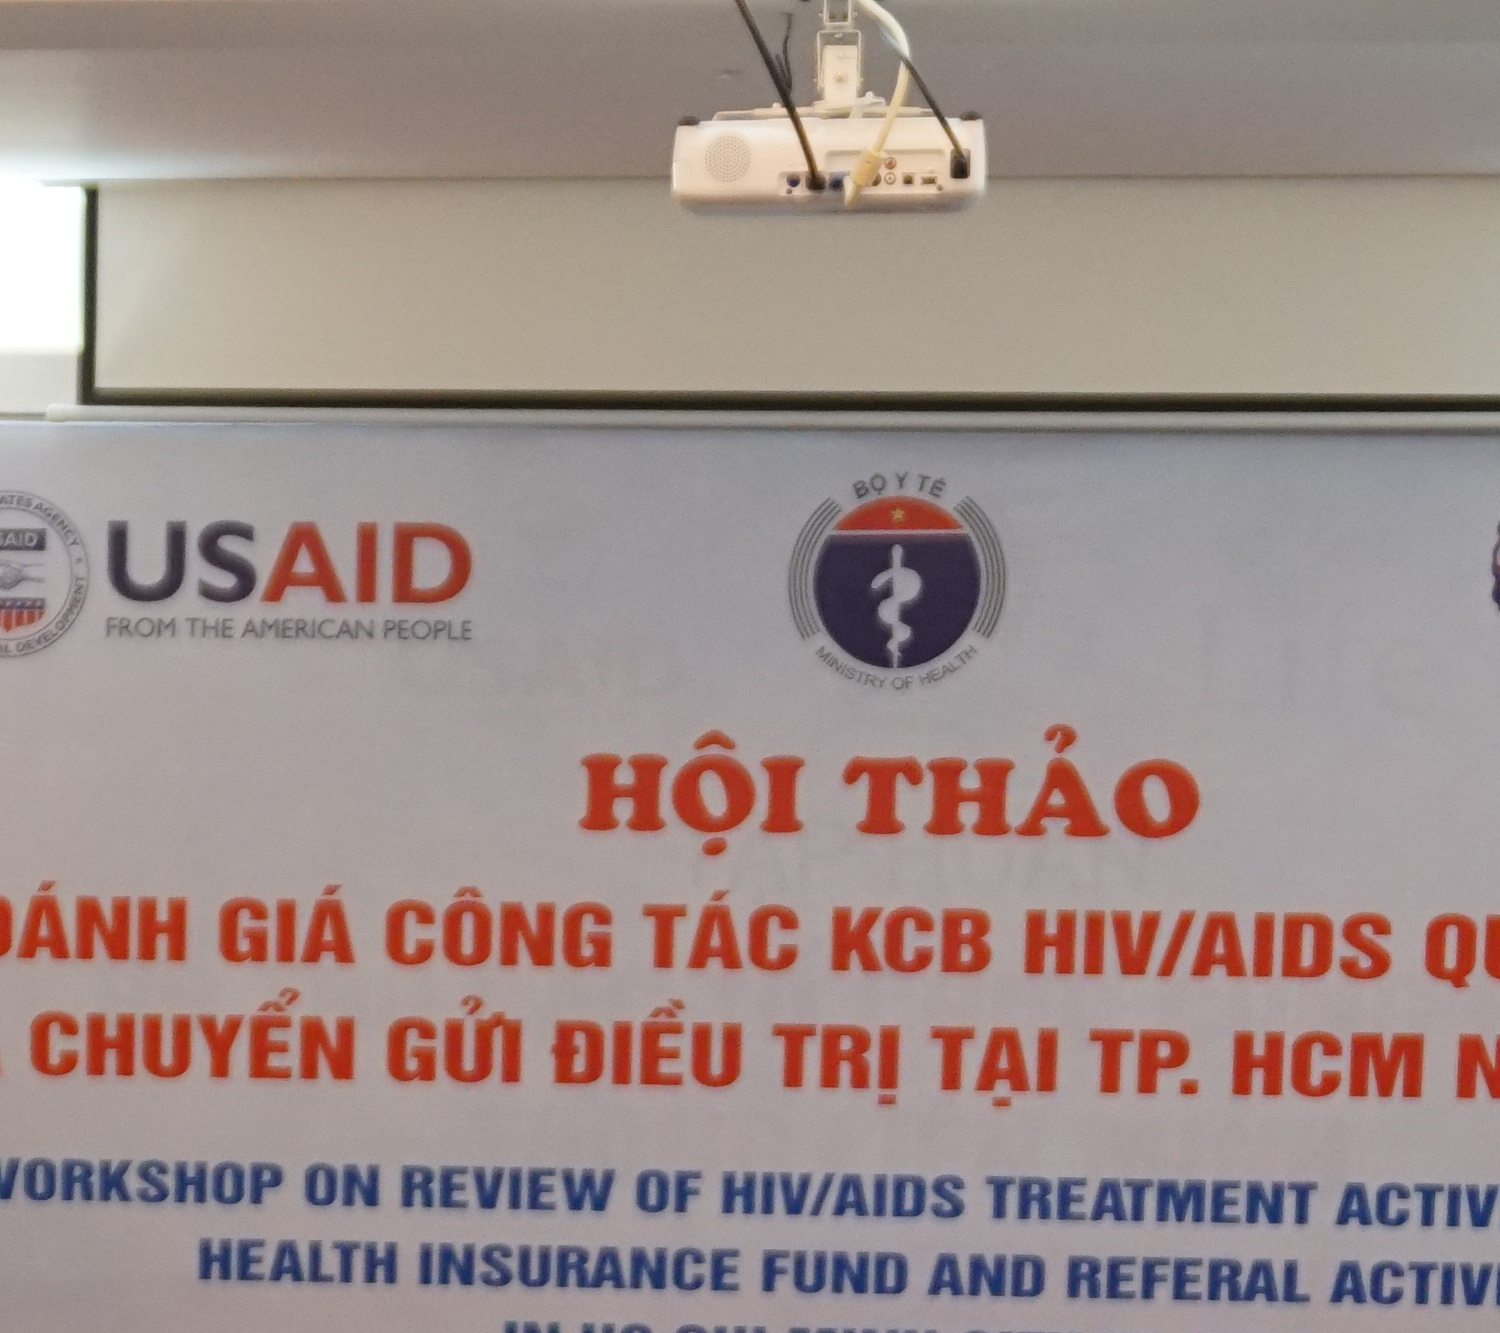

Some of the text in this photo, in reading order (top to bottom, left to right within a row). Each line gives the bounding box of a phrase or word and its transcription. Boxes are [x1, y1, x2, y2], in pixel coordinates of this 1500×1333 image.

[896, 472, 909, 489] Y
[108, 522, 472, 604] USAID
[106, 617, 472, 642] FROM THE AMERICAN PEOPLE
[815, 644, 978, 691] MINISTRY OF HEALTH
[580, 724, 1200, 857] HỘI THẢO
[219, 886, 355, 964] GIÁ
[386, 888, 612, 969] CÔNG
[643, 892, 799, 972] TÁC
[831, 907, 991, 974] KCB
[1024, 910, 1391, 980] HIV/AIDS
[30, 994, 355, 1081] CHUYỂN
[387, 997, 522, 1084] GỬI
[551, 1001, 742, 1088] ĐIỀU
[772, 1024, 899, 1105] TRỊ
[930, 1027, 1058, 1107] TẠI
[1090, 1030, 1198, 1095] TP.
[1232, 1032, 1424, 1098] HCM
[305, 1164, 379, 1207] ON
[401, 1166, 614, 1212] REVIEW
[636, 1171, 701, 1213] OF
[722, 1172, 964, 1219] HIV/AIDS
[986, 1177, 1317, 1225] TREATMENT
[199, 1239, 397, 1285] HEALTH
[419, 1244, 739, 1291] INSURANCE
[762, 1251, 908, 1295] FUND
[928, 1254, 1045, 1298] AND
[1067, 1257, 1310, 1303] REFERAL
